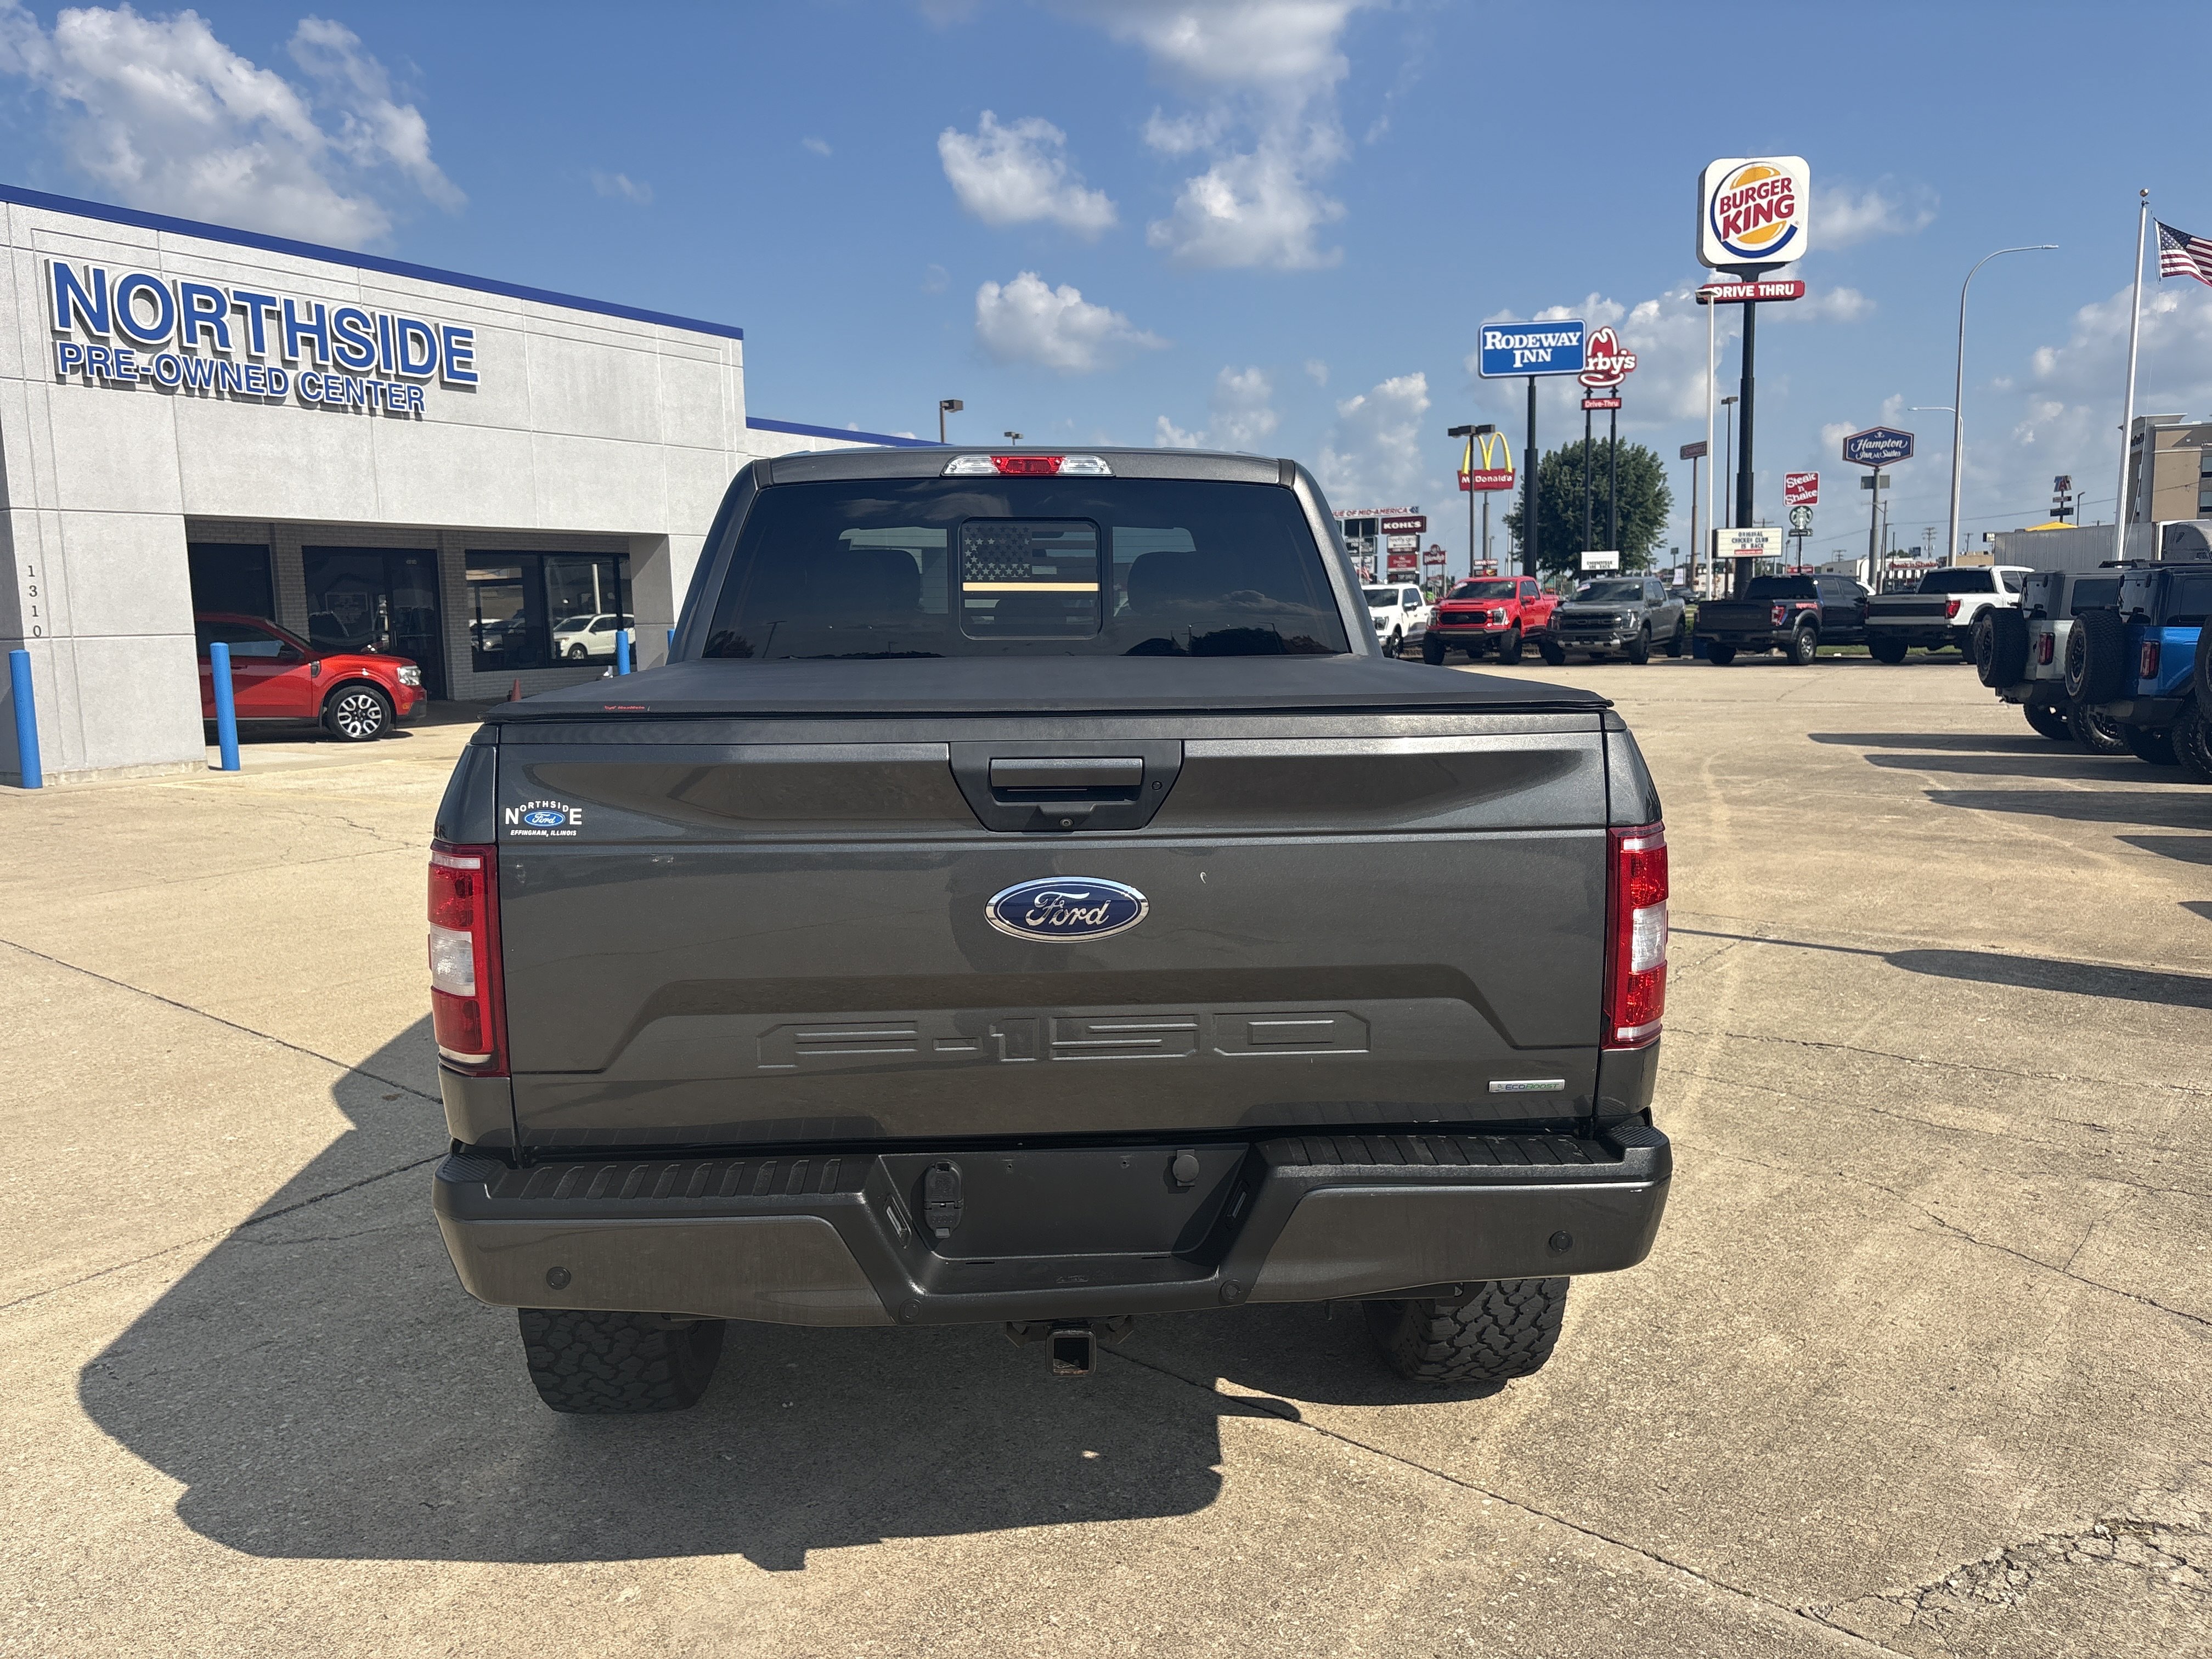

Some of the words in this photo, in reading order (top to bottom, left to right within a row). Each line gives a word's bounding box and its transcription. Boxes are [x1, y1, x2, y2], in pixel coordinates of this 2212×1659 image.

[1720, 178, 1792, 216] BURGER
[1722, 194, 1795, 240] KING
[1713, 285, 1755, 298] DRIVE
[1758, 284, 1795, 296] THRU
[47, 258, 481, 386] NORTHSIDE
[1484, 331, 1582, 349] RODEWAY
[1513, 348, 1553, 368] INN
[1585, 349, 1636, 374] rby's
[58, 341, 291, 397] PRE-OWNED
[298, 370, 427, 414] CENTER
[1851, 438, 1908, 453] Hampton
[1855, 451, 1873, 460] Inn
[1462, 475, 1513, 484] MDonald's
[1786, 473, 1816, 488] Steak
[1785, 489, 1818, 505] Shake
[1383, 521, 1421, 530] KOHL'S
[505, 801, 582, 825] NORTHSIDE
[532, 813, 556, 823] Ford
[1025, 891, 1111, 926] Ford
[756, 1009, 1370, 1070] F-150
